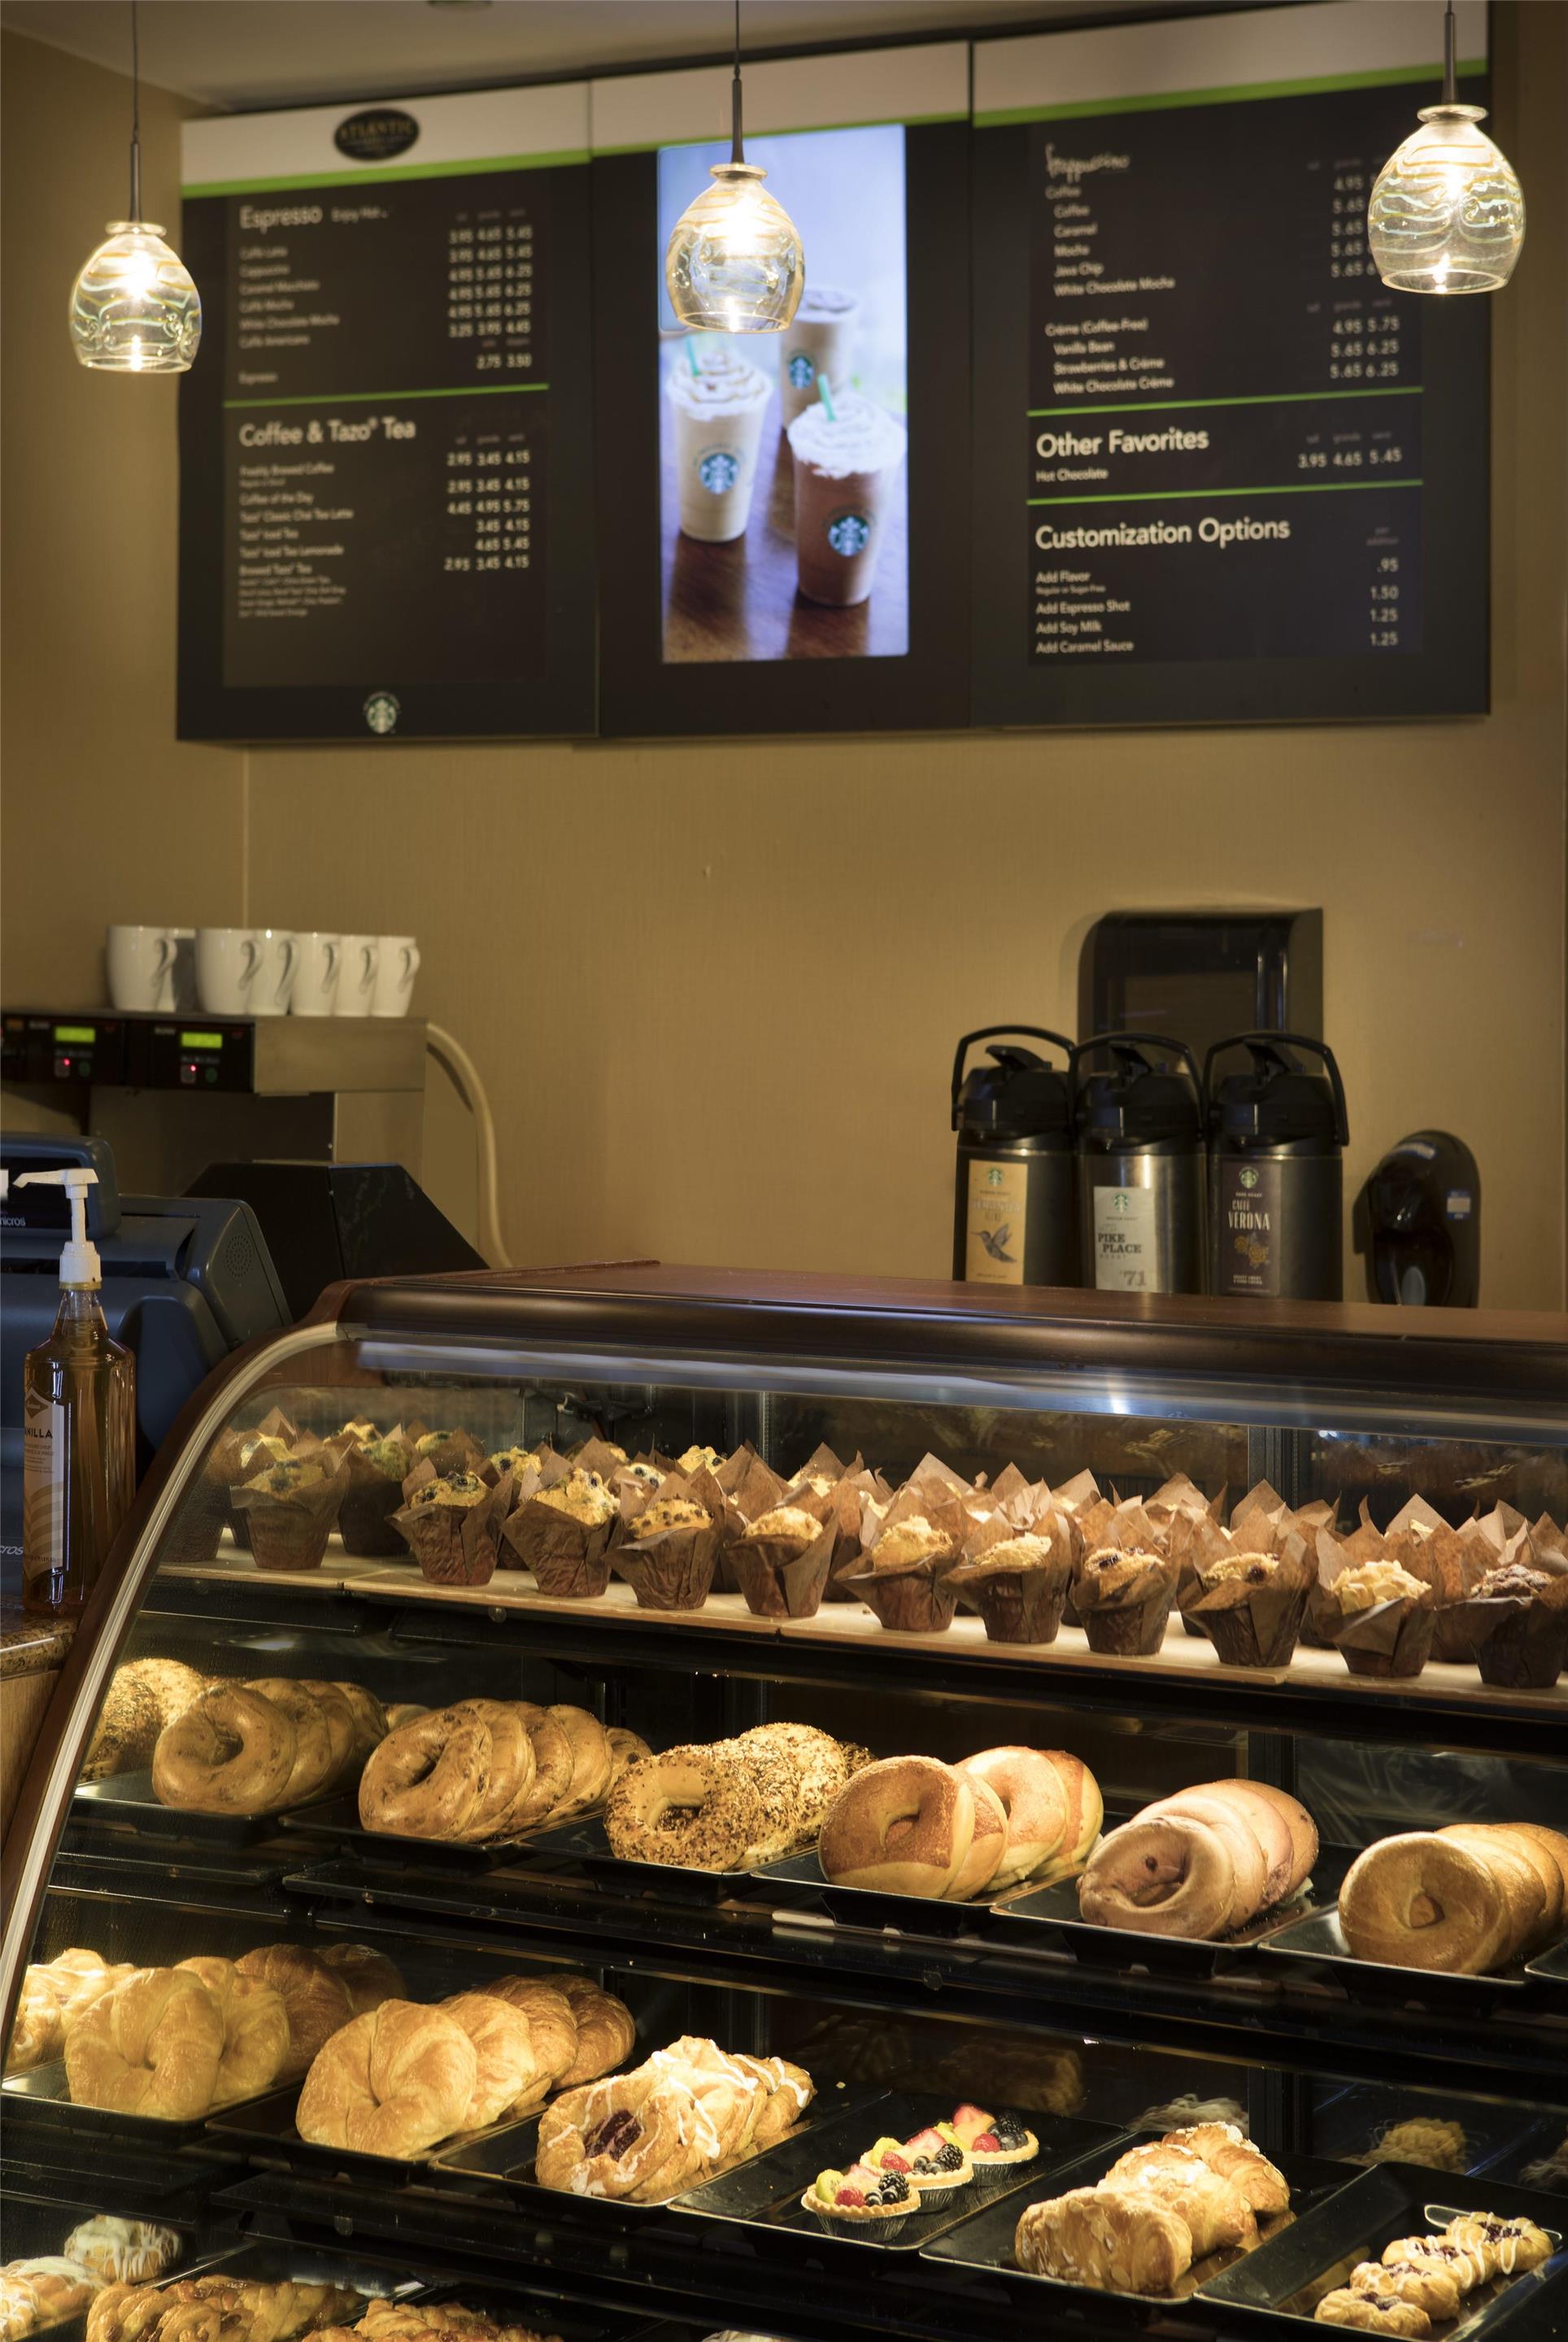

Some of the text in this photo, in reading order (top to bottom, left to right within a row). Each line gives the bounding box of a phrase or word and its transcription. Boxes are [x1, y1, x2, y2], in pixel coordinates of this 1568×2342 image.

[240, 207, 323, 233] Espresso
[1086, 280, 1138, 294] Chocolate
[1086, 377, 1138, 393] Chocolate
[239, 422, 303, 446] Coffee
[307, 420, 324, 444] &
[381, 416, 416, 440] Tea
[1035, 425, 1210, 458] Other Favorites
[1036, 466, 1108, 481] Hot Chocolate
[1034, 516, 1291, 551] Customization Options
[1035, 570, 1091, 583] Add Flavor
[1370, 586, 1399, 600] 1.50
[1035, 599, 1131, 616] Add Espresso Shot
[1370, 608, 1399, 623] 1.25
[1035, 619, 1103, 636] Add Soy Milk
[1035, 638, 1135, 654] Add Caramel Sauce
[1370, 631, 1399, 646] 1.25
[1228, 1212, 1270, 1231] VERONA
[1098, 1233, 1126, 1243] PIKE
[1102, 1243, 1142, 1254] PLACE
